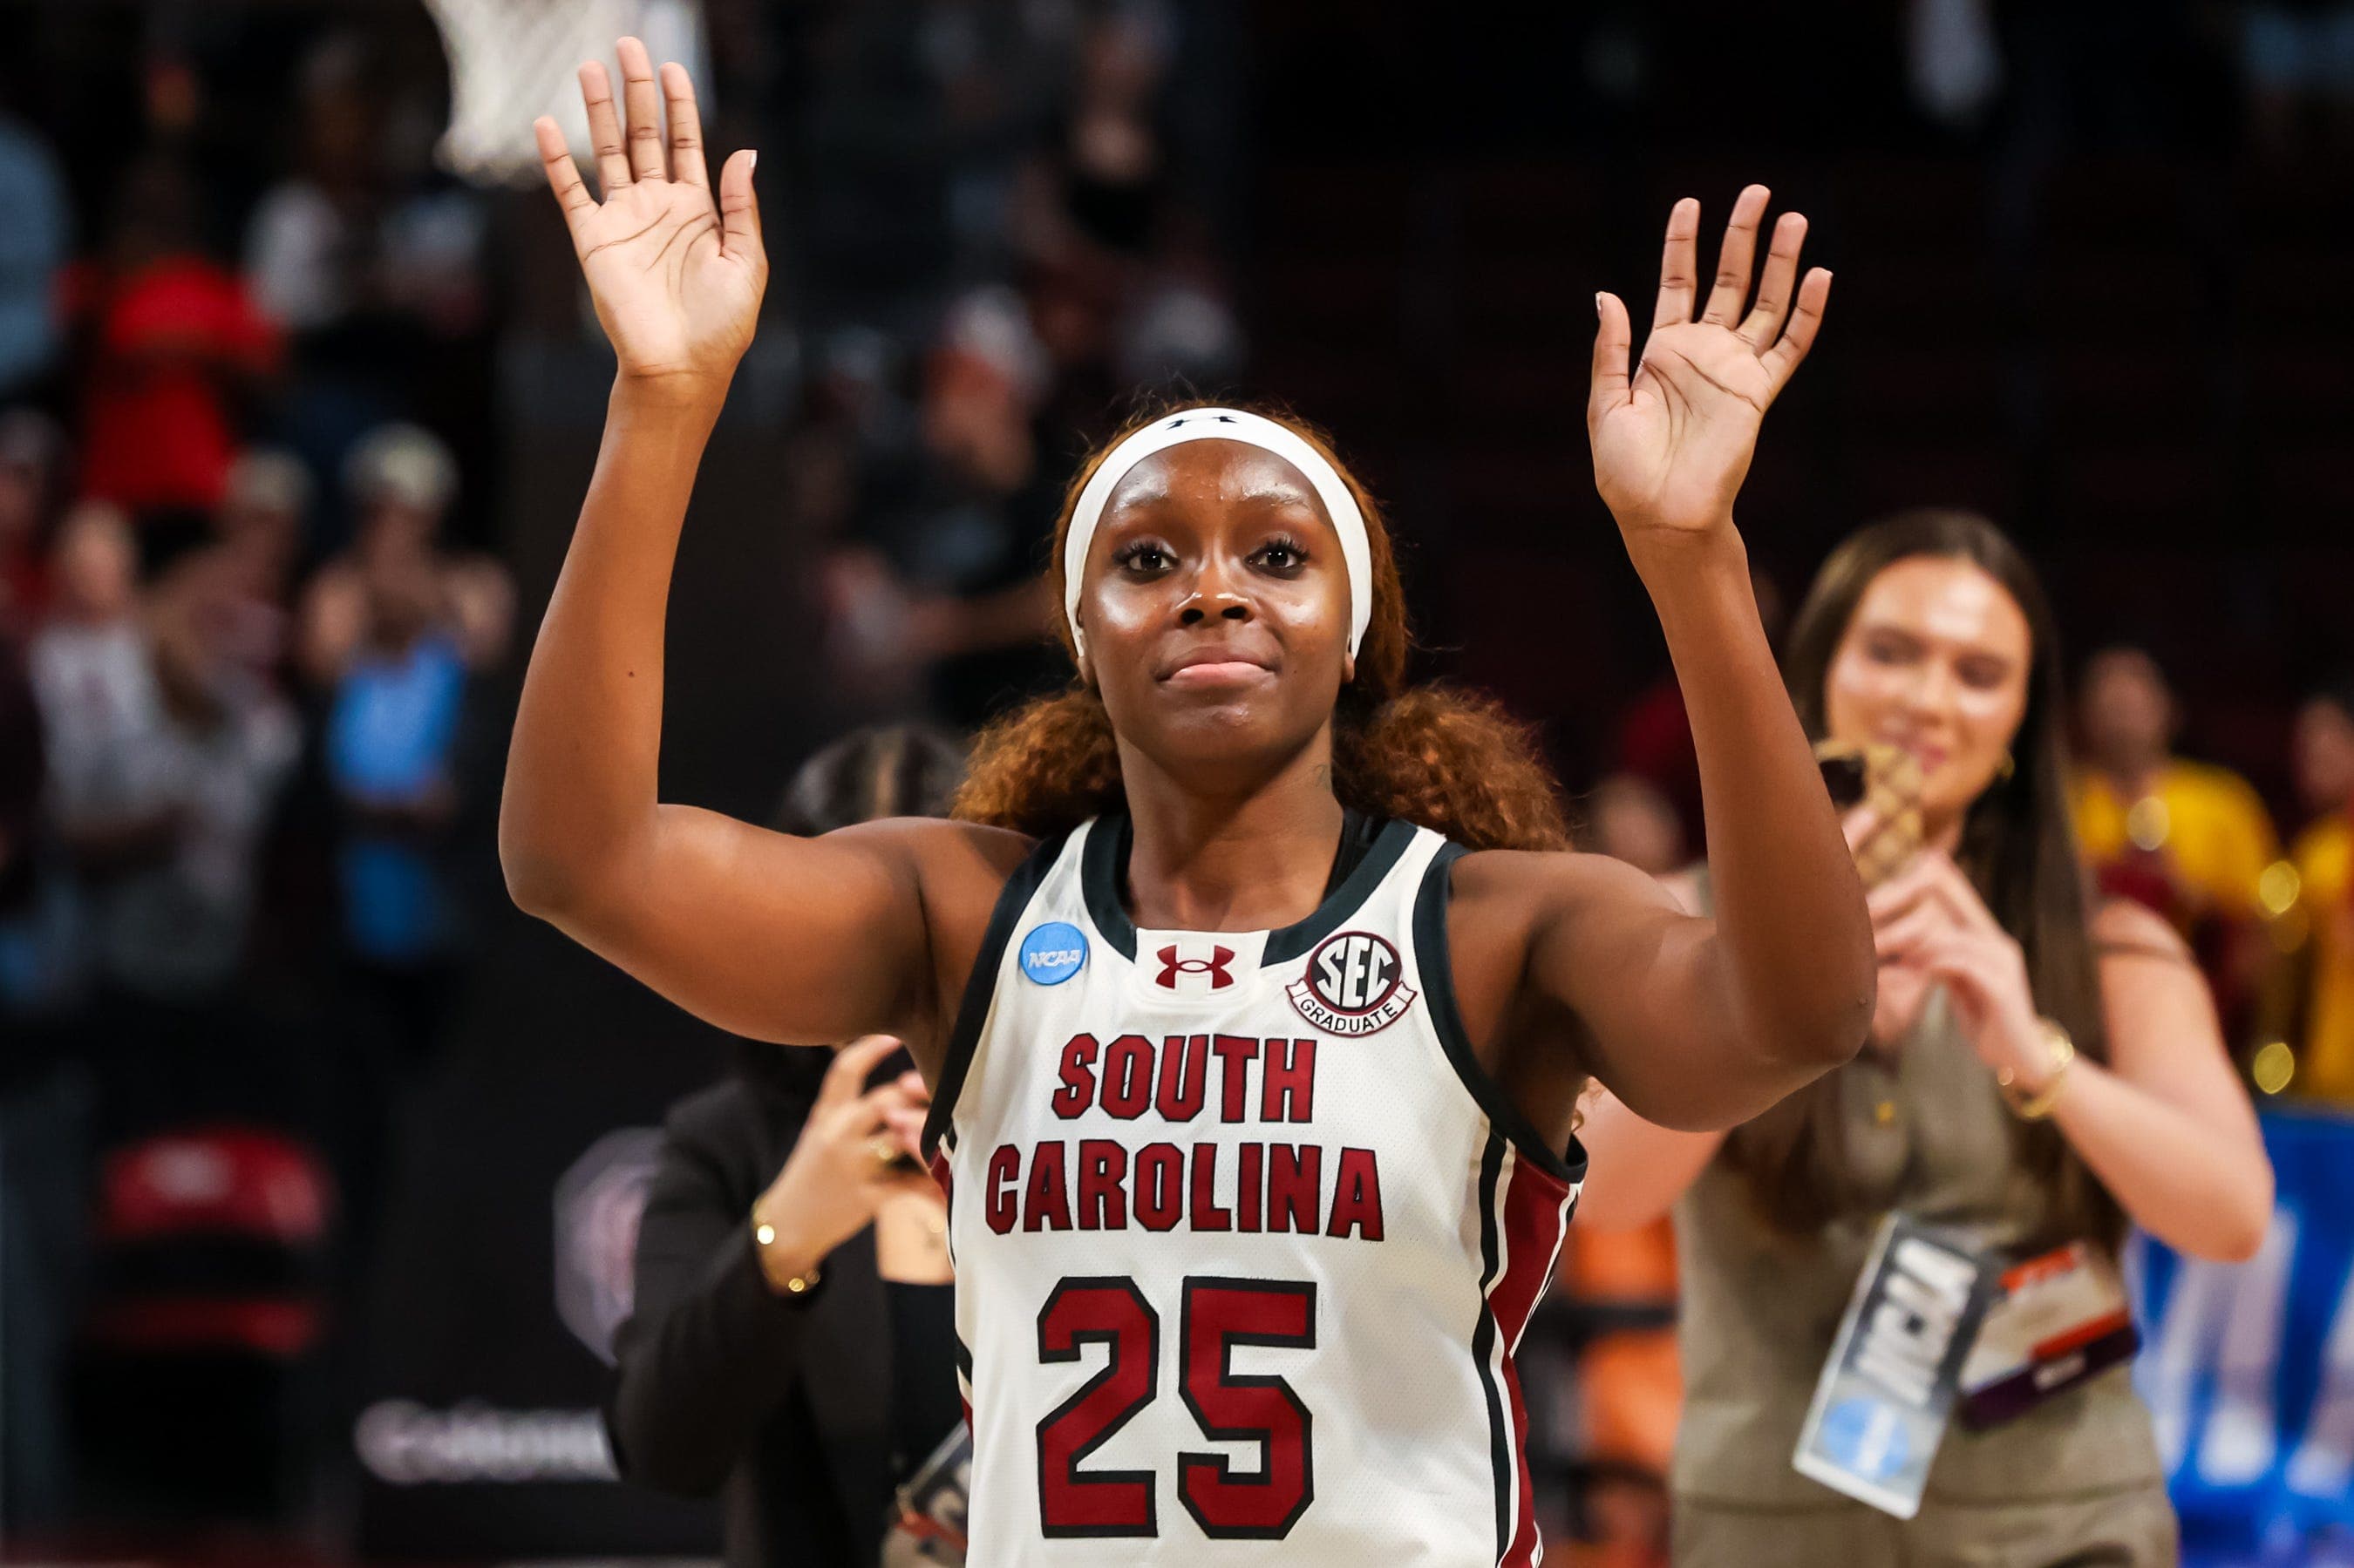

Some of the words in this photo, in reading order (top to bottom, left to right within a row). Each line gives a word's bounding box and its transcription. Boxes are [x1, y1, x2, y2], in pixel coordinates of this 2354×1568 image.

[1028, 949, 1081, 970] NCAA
[1316, 935, 1394, 1008] SEC
[1299, 999, 1398, 1033] GRADUATE
[1051, 1032, 1317, 1123] SOUTH
[985, 1138, 1385, 1242] CAROLINA
[1036, 1275, 1317, 1540] 25
